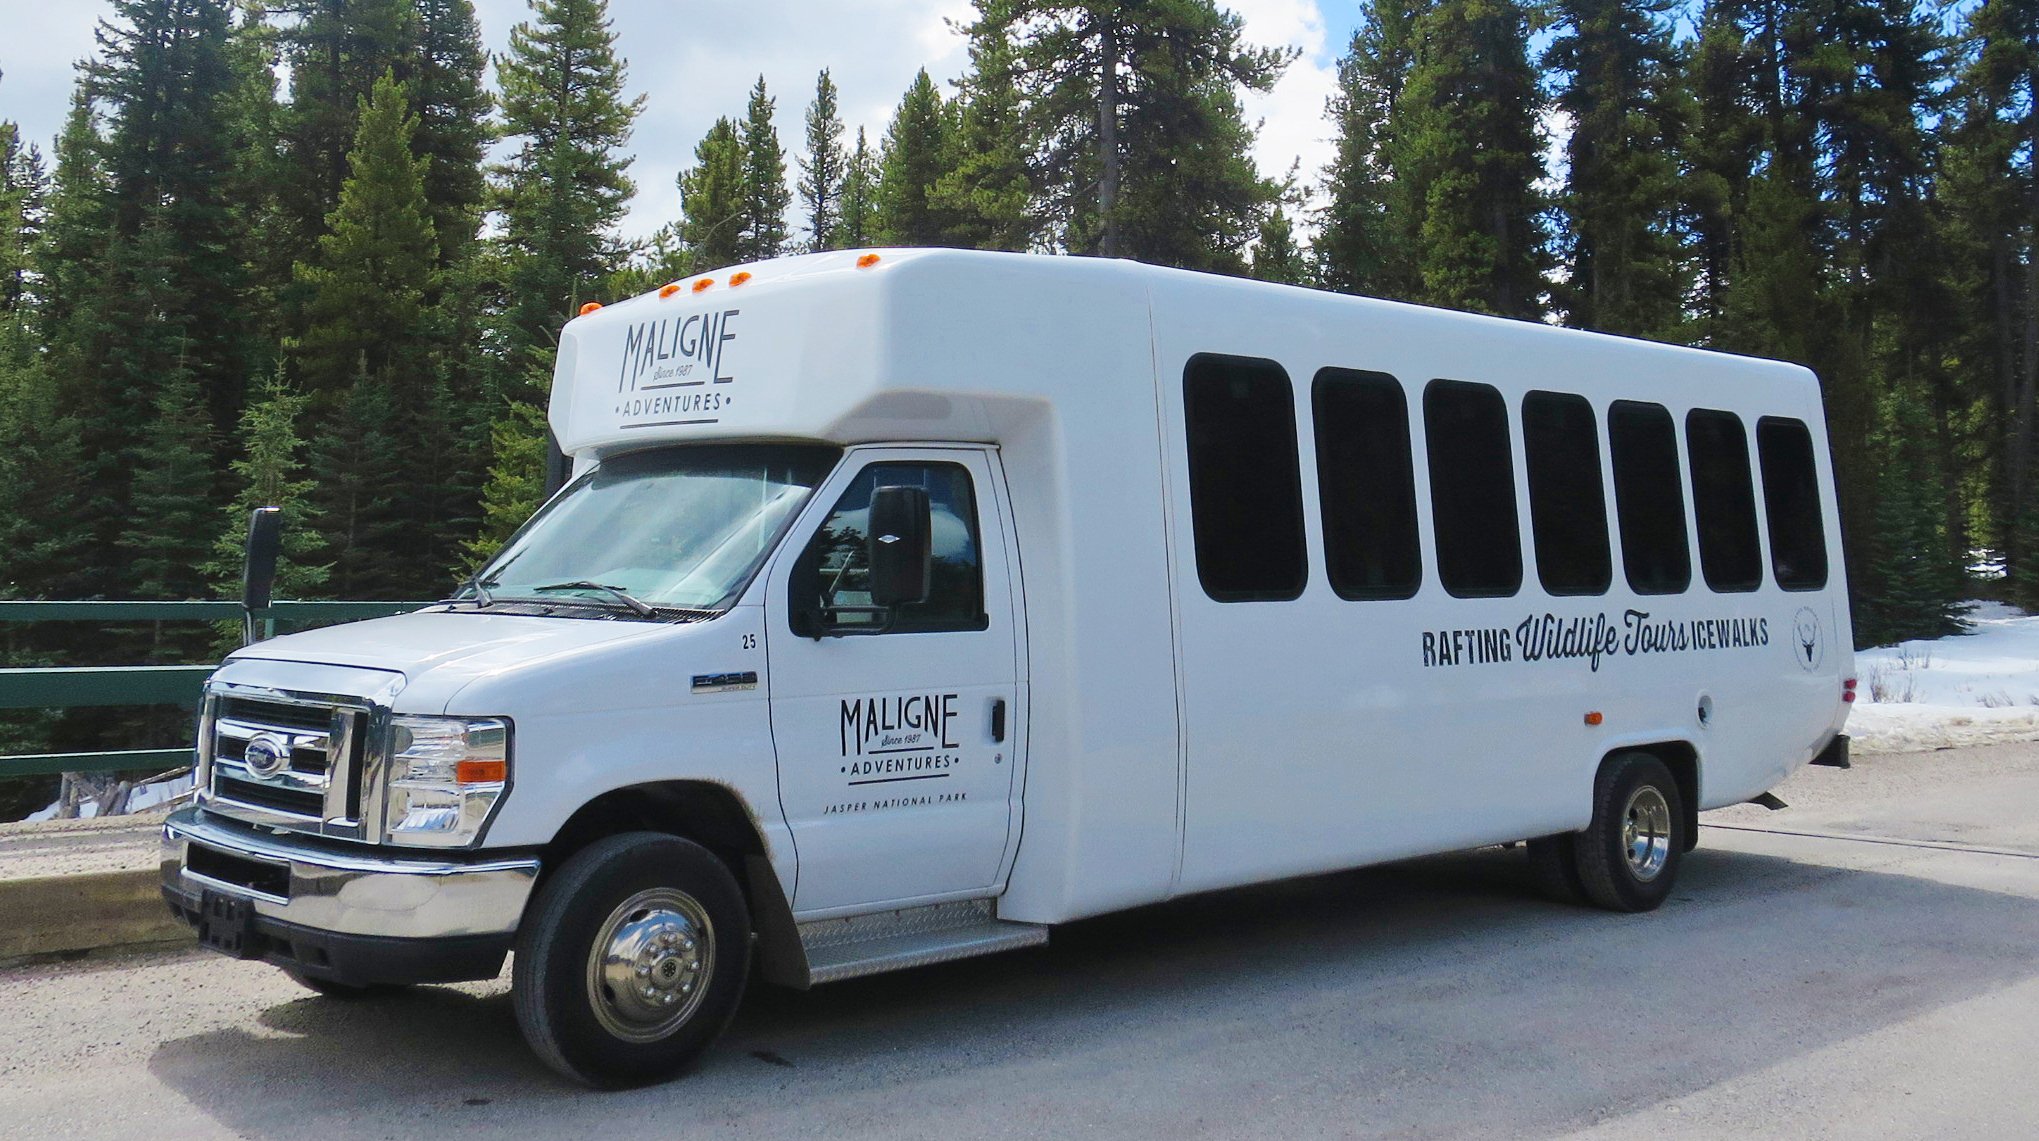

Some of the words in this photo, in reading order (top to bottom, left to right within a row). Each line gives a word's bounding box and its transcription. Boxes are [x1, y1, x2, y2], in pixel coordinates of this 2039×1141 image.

[618, 310, 740, 393] MALIGNE
[622, 393, 721, 417] ADVENTURES
[742, 633, 756, 649] 25
[1422, 628, 1512, 667] RAFTING
[1515, 612, 1620, 672] Wildlife
[1624, 609, 1690, 656] Tours
[1690, 617, 1769, 650] ICEWALKS
[841, 694, 960, 757] MALIGNE
[850, 755, 950, 776] ADVENTURES
[824, 802, 867, 815] JASPER
[873, 796, 932, 811] NATIONAL
[939, 792, 967, 803] PARK
